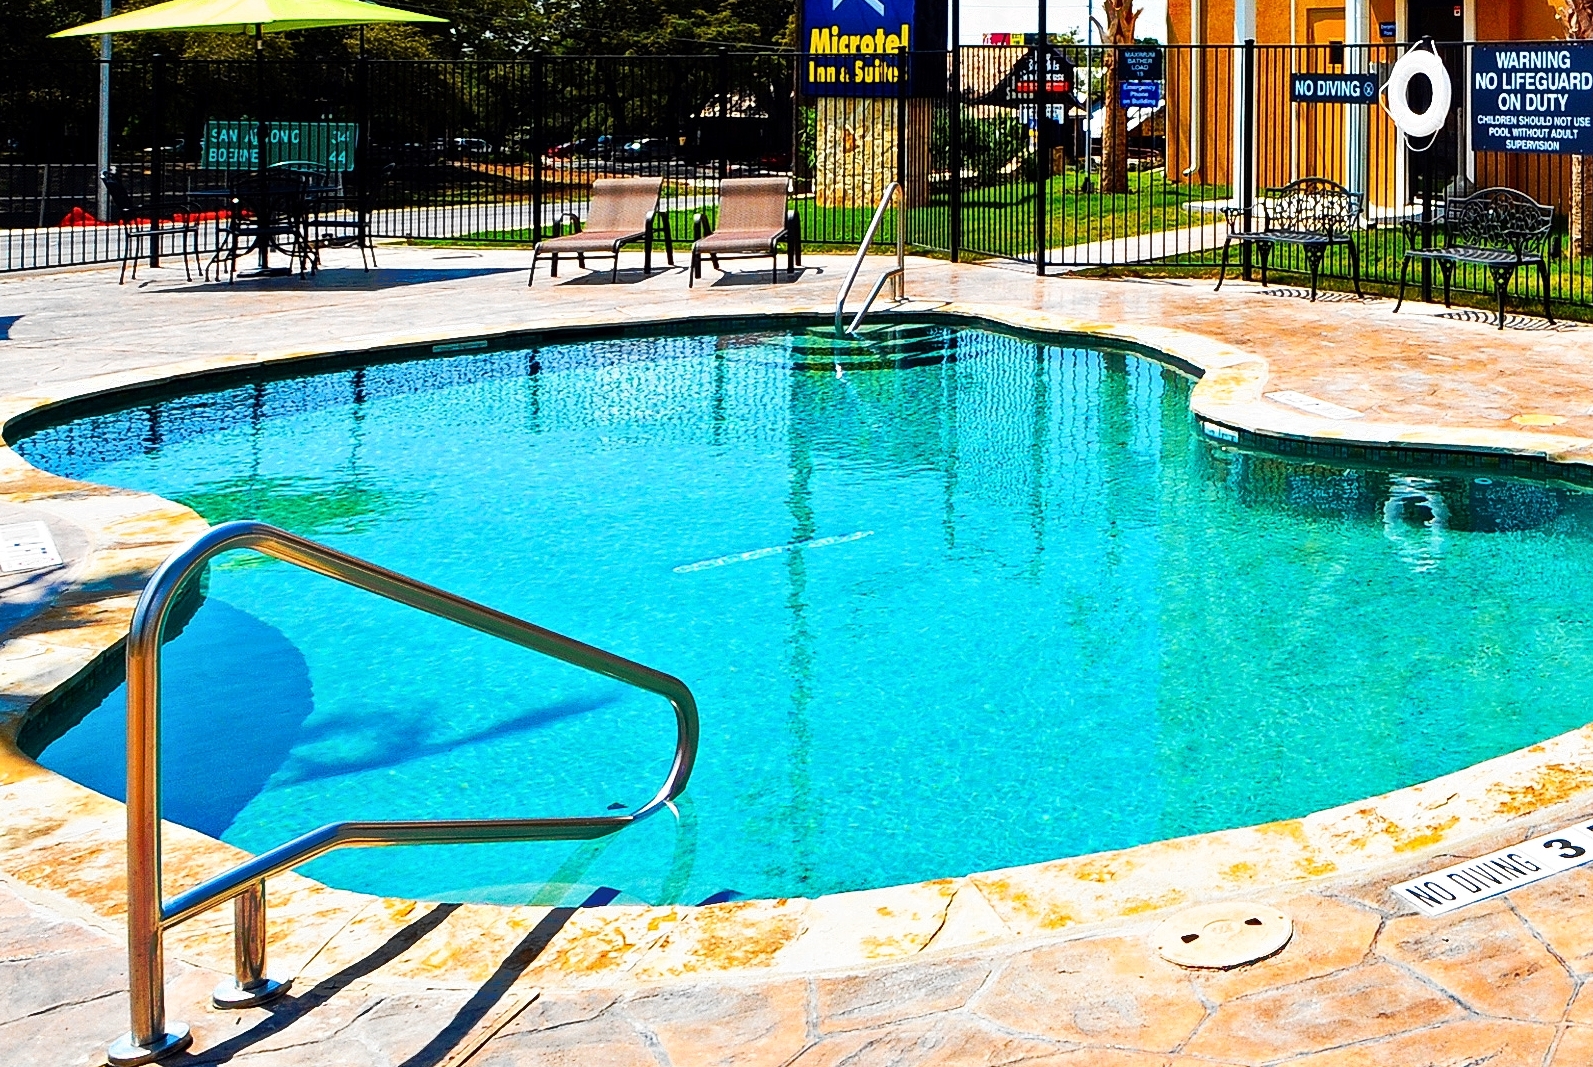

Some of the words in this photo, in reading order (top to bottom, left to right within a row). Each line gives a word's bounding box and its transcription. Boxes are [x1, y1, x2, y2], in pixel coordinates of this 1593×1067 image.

[810, 24, 909, 54] Microtel
[1495, 51, 1571, 69] WARNING
[809, 61, 835, 83] Inn
[855, 59, 908, 83] Suite
[1295, 80, 1313, 96] NO
[1317, 80, 1361, 97] DIVING
[1475, 72, 1498, 90] NO
[1502, 72, 1593, 90] LIFEGUARD
[1498, 93, 1521, 111] ON
[1525, 93, 1569, 112] DUTY
[1477, 115, 1517, 125] CHILDREN
[1518, 116, 1552, 126] SHOULD
[1553, 117, 1572, 126] NOT
[1573, 117, 1591, 127] USE
[1488, 127, 1511, 137] POOL
[1512, 128, 1549, 138] WITHOUT
[1550, 129, 1578, 139] ADULT
[1505, 140, 1560, 151] SUPERVISION
[329, 150, 346, 164] 44
[1405, 882, 1457, 908] NO
[1446, 853, 1542, 894] DIVING
[1543, 838, 1586, 859] 3
